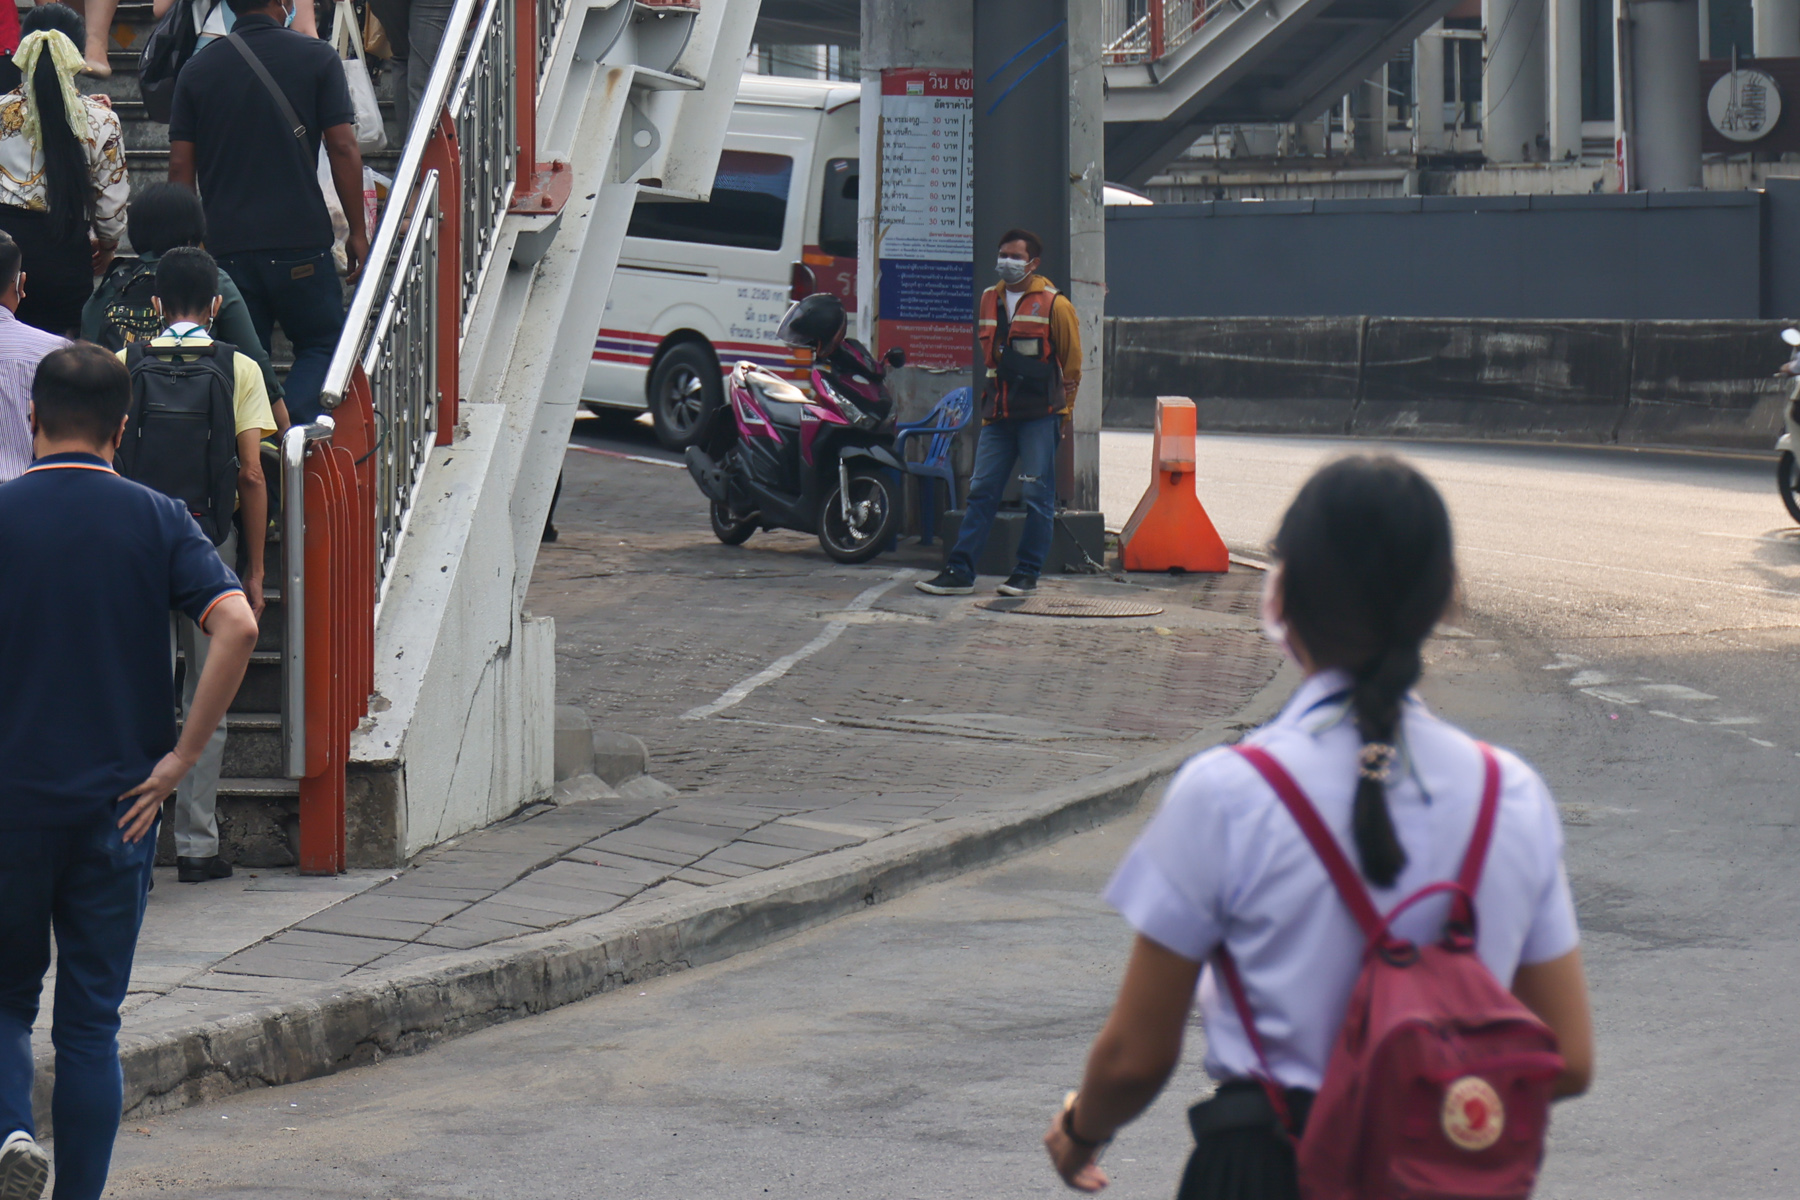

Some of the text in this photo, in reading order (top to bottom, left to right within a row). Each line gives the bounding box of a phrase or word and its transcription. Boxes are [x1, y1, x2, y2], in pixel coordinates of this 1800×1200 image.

[929, 72, 948, 89] วิน
[955, 77, 973, 90] เซ
[1032, 302, 1041, 316] 2
